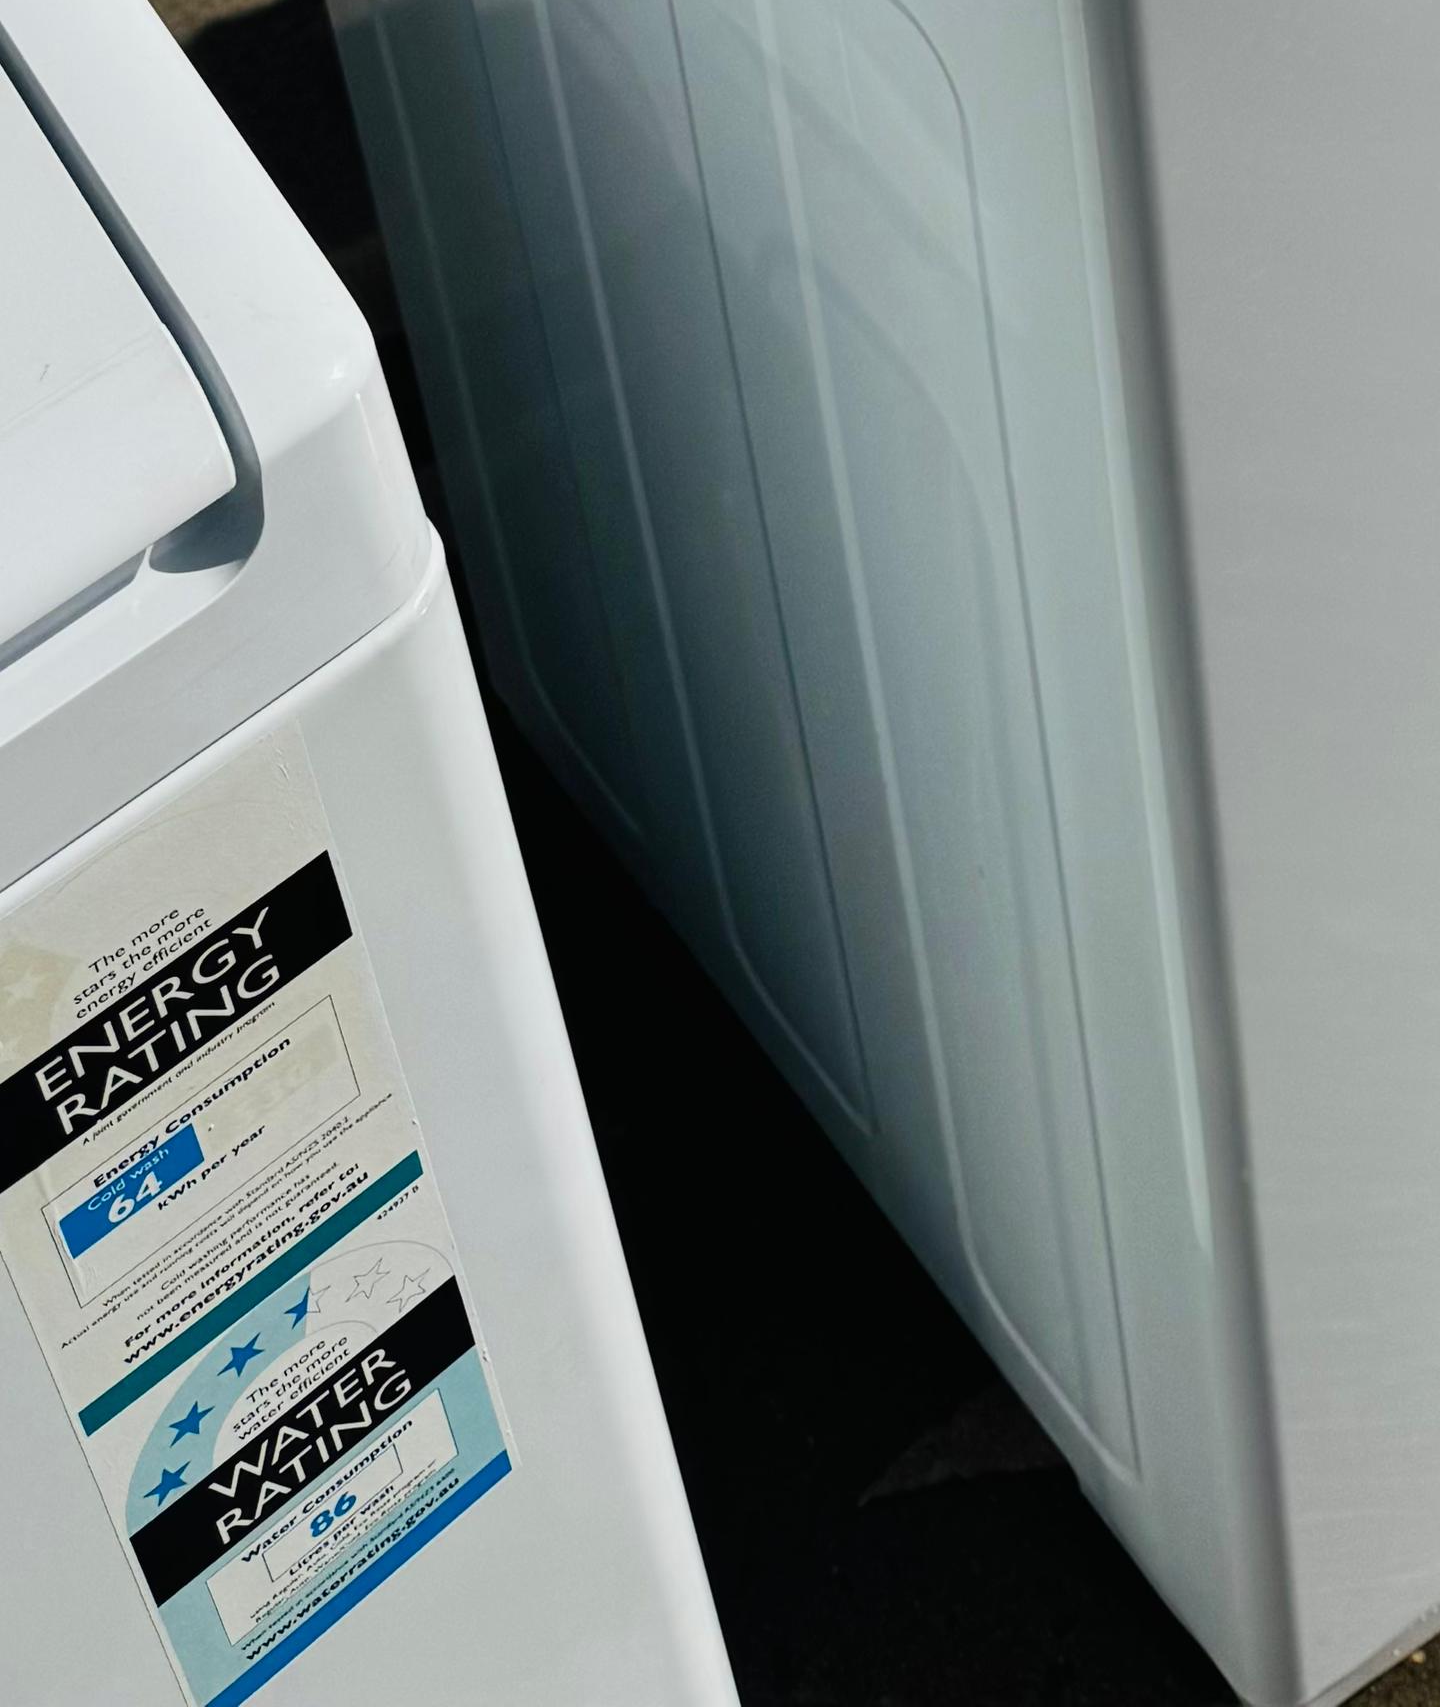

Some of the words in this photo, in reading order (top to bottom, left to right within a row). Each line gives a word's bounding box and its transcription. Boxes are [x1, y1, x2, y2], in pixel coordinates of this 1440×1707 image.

[73, 970, 116, 1004] stars
[121, 945, 151, 969] the
[157, 907, 204, 945] more
[76, 971, 136, 1019] energy
[142, 918, 211, 971] efficient
[88, 947, 125, 973] The
[131, 909, 179, 946] more
[34, 906, 269, 1101] ENERGY
[56, 953, 280, 1135] RATING
[92, 1119, 114, 1141] joint
[116, 1076, 172, 1123] government
[175, 1059, 193, 1078] and
[196, 1032, 233, 1062] industry
[236, 1001, 275, 1034] program
[93, 1134, 159, 1188] Energy
[164, 1038, 290, 1134] Consumption
[87, 1177, 126, 1210] Cold
[129, 1148, 169, 1179] wash
[107, 1170, 163, 1223] 64
[157, 1178, 197, 1210] kWh
[200, 1154, 227, 1180] per
[231, 1125, 265, 1156] year
[61, 1325, 89, 1349] Actual
[91, 1301, 121, 1326] energy
[123, 1288, 139, 1302] use
[141, 1272, 157, 1288] and
[159, 1246, 193, 1274] running
[194, 1228, 218, 1247] costs
[237, 1187, 269, 1214] depend
[270, 1177, 282, 1189] on
[283, 1161, 303, 1178] how
[305, 1148, 321, 1163] you
[322, 1135, 337, 1148] use
[339, 1123, 353, 1135] the
[102, 1285, 131, 1307] When
[132, 1261, 160, 1285] tested
[162, 1254, 172, 1263] in
[173, 1215, 222, 1254] accordance
[224, 1198, 244, 1214] with
[245, 1166, 284, 1198] Standard
[123, 1171, 368, 1363] www.energyrating.gov.au
[124, 1324, 151, 1347] For
[155, 1290, 197, 1324] more
[200, 1215, 295, 1289] information,
[298, 1180, 335, 1213] refer
[338, 1162, 359, 1181] to:
[136, 1304, 154, 1320] not
[156, 1284, 182, 1305] been
[183, 1243, 232, 1283] measured
[234, 1227, 252, 1245] and
[254, 1221, 263, 1229] is
[265, 1205, 283, 1221] not
[160, 1268, 186, 1290] Cold
[188, 1237, 228, 1269] washing
[229, 1188, 292, 1239] performance
[293, 1174, 310, 1188] has
[207, 1348, 396, 1497] WATER
[232, 1399, 271, 1432] stars
[275, 1374, 300, 1397] the
[305, 1336, 347, 1373] more
[238, 1400, 283, 1440] water
[289, 1348, 349, 1400] efficient
[245, 1378, 278, 1403] The
[283, 1340, 325, 1377] more
[215, 1368, 411, 1544] RATING
[240, 1515, 297, 1562] Water
[301, 1420, 412, 1518] Consumption
[309, 1490, 357, 1537] 86
[245, 1477, 459, 1660] www.waterrating.gov.au
[289, 1540, 329, 1576] Litres
[332, 1516, 356, 1541] per
[359, 1485, 394, 1515] wash
